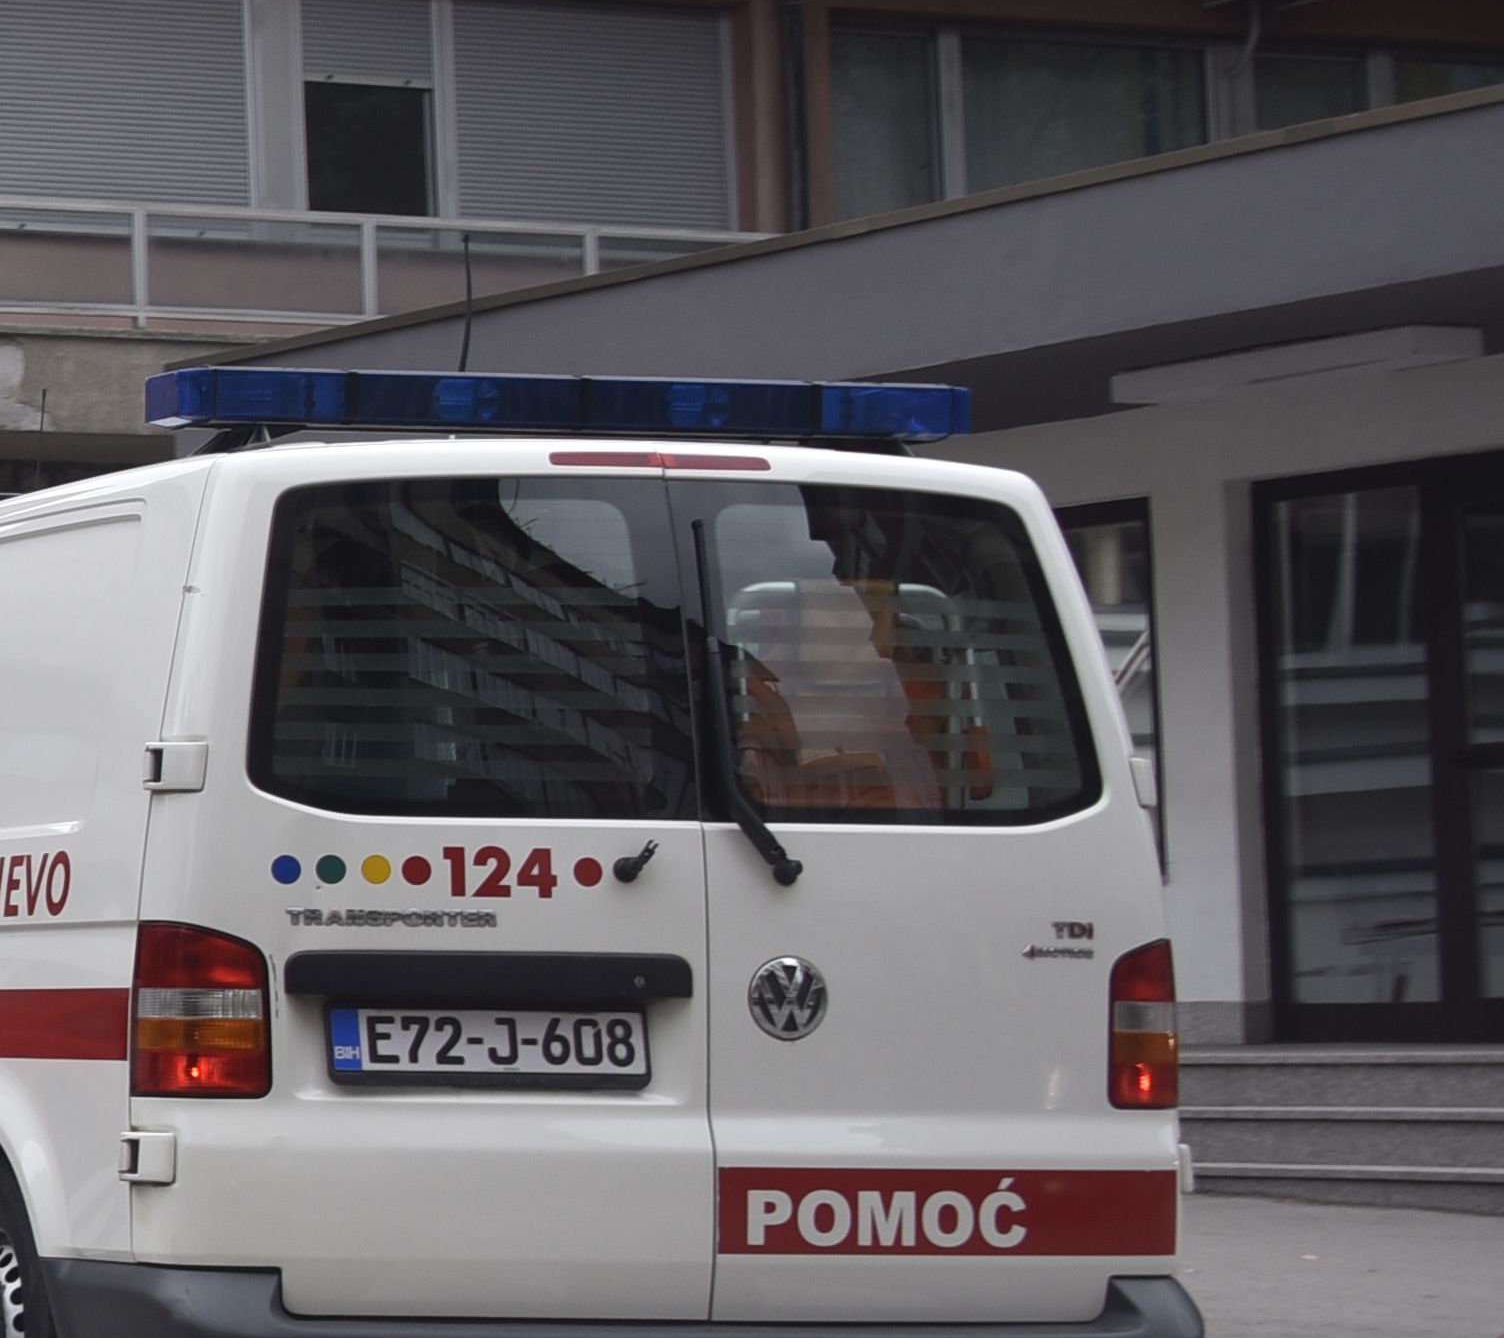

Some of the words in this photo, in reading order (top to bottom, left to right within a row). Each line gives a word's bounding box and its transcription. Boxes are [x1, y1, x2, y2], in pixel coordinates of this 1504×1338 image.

[442, 845, 558, 898] 124
[285, 908, 498, 928] TRANSPORTER
[1051, 921, 1094, 940] TDI
[334, 1046, 360, 1060] BIH
[365, 1015, 636, 1067] E72-J-608
[746, 1177, 1028, 1248] POMOĆ
